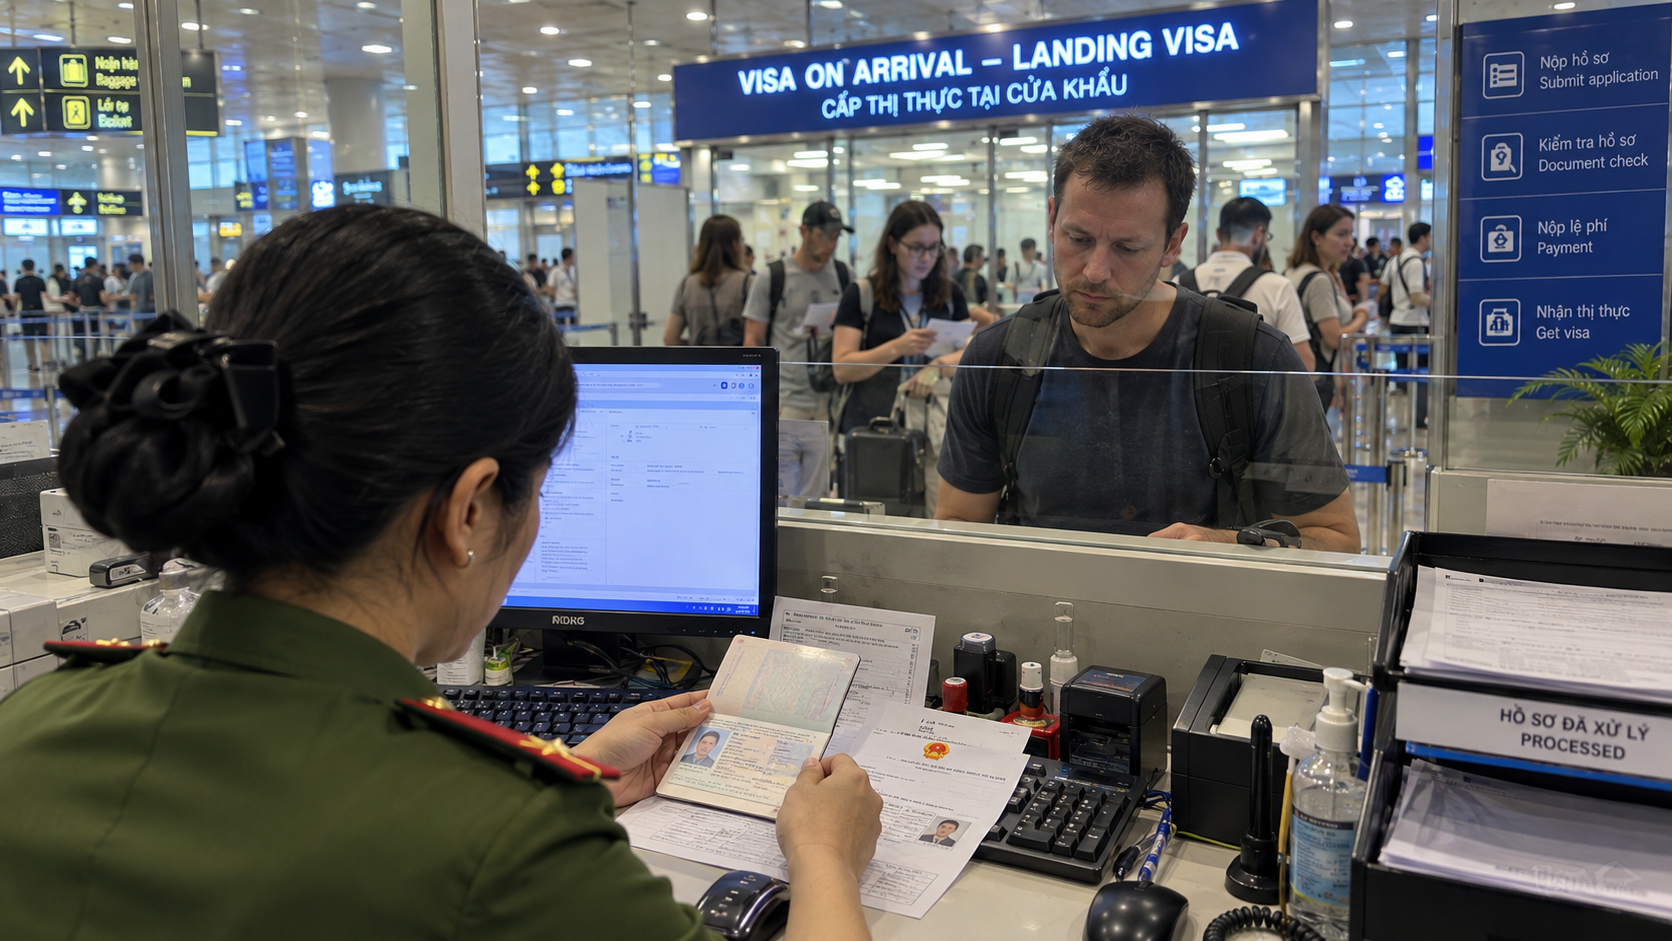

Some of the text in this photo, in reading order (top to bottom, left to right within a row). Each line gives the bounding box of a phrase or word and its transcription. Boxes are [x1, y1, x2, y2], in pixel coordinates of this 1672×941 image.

[738, 66, 797, 96] VISA
[805, 61, 845, 90] ON
[852, 49, 973, 85] ARRIVAL
[1013, 30, 1153, 71] LANDING
[1162, 22, 1240, 56] VISA
[1540, 50, 1610, 71] Nộp hồ sơ
[1539, 68, 1659, 90] Submit application
[865, 93, 899, 118] THỊ
[903, 87, 963, 115] THỰC
[967, 84, 1000, 110] TẠI
[1006, 74, 1057, 104] CỬA
[1063, 66, 1127, 100] KHẨU
[1576, 137, 1594, 149] tra
[1619, 134, 1637, 147] sơ
[1538, 153, 1649, 172] Document check
[1537, 218, 1608, 237] Nộp lệ phí
[1537, 241, 1593, 257] Payment
[1536, 304, 1631, 321] Nhận thị thực
[1536, 325, 1591, 340] Get visa
[1500, 703, 1650, 742] HỒ SƠ ĐÃ XỬ LÝ
[1521, 733, 1626, 760] PROCESSED
